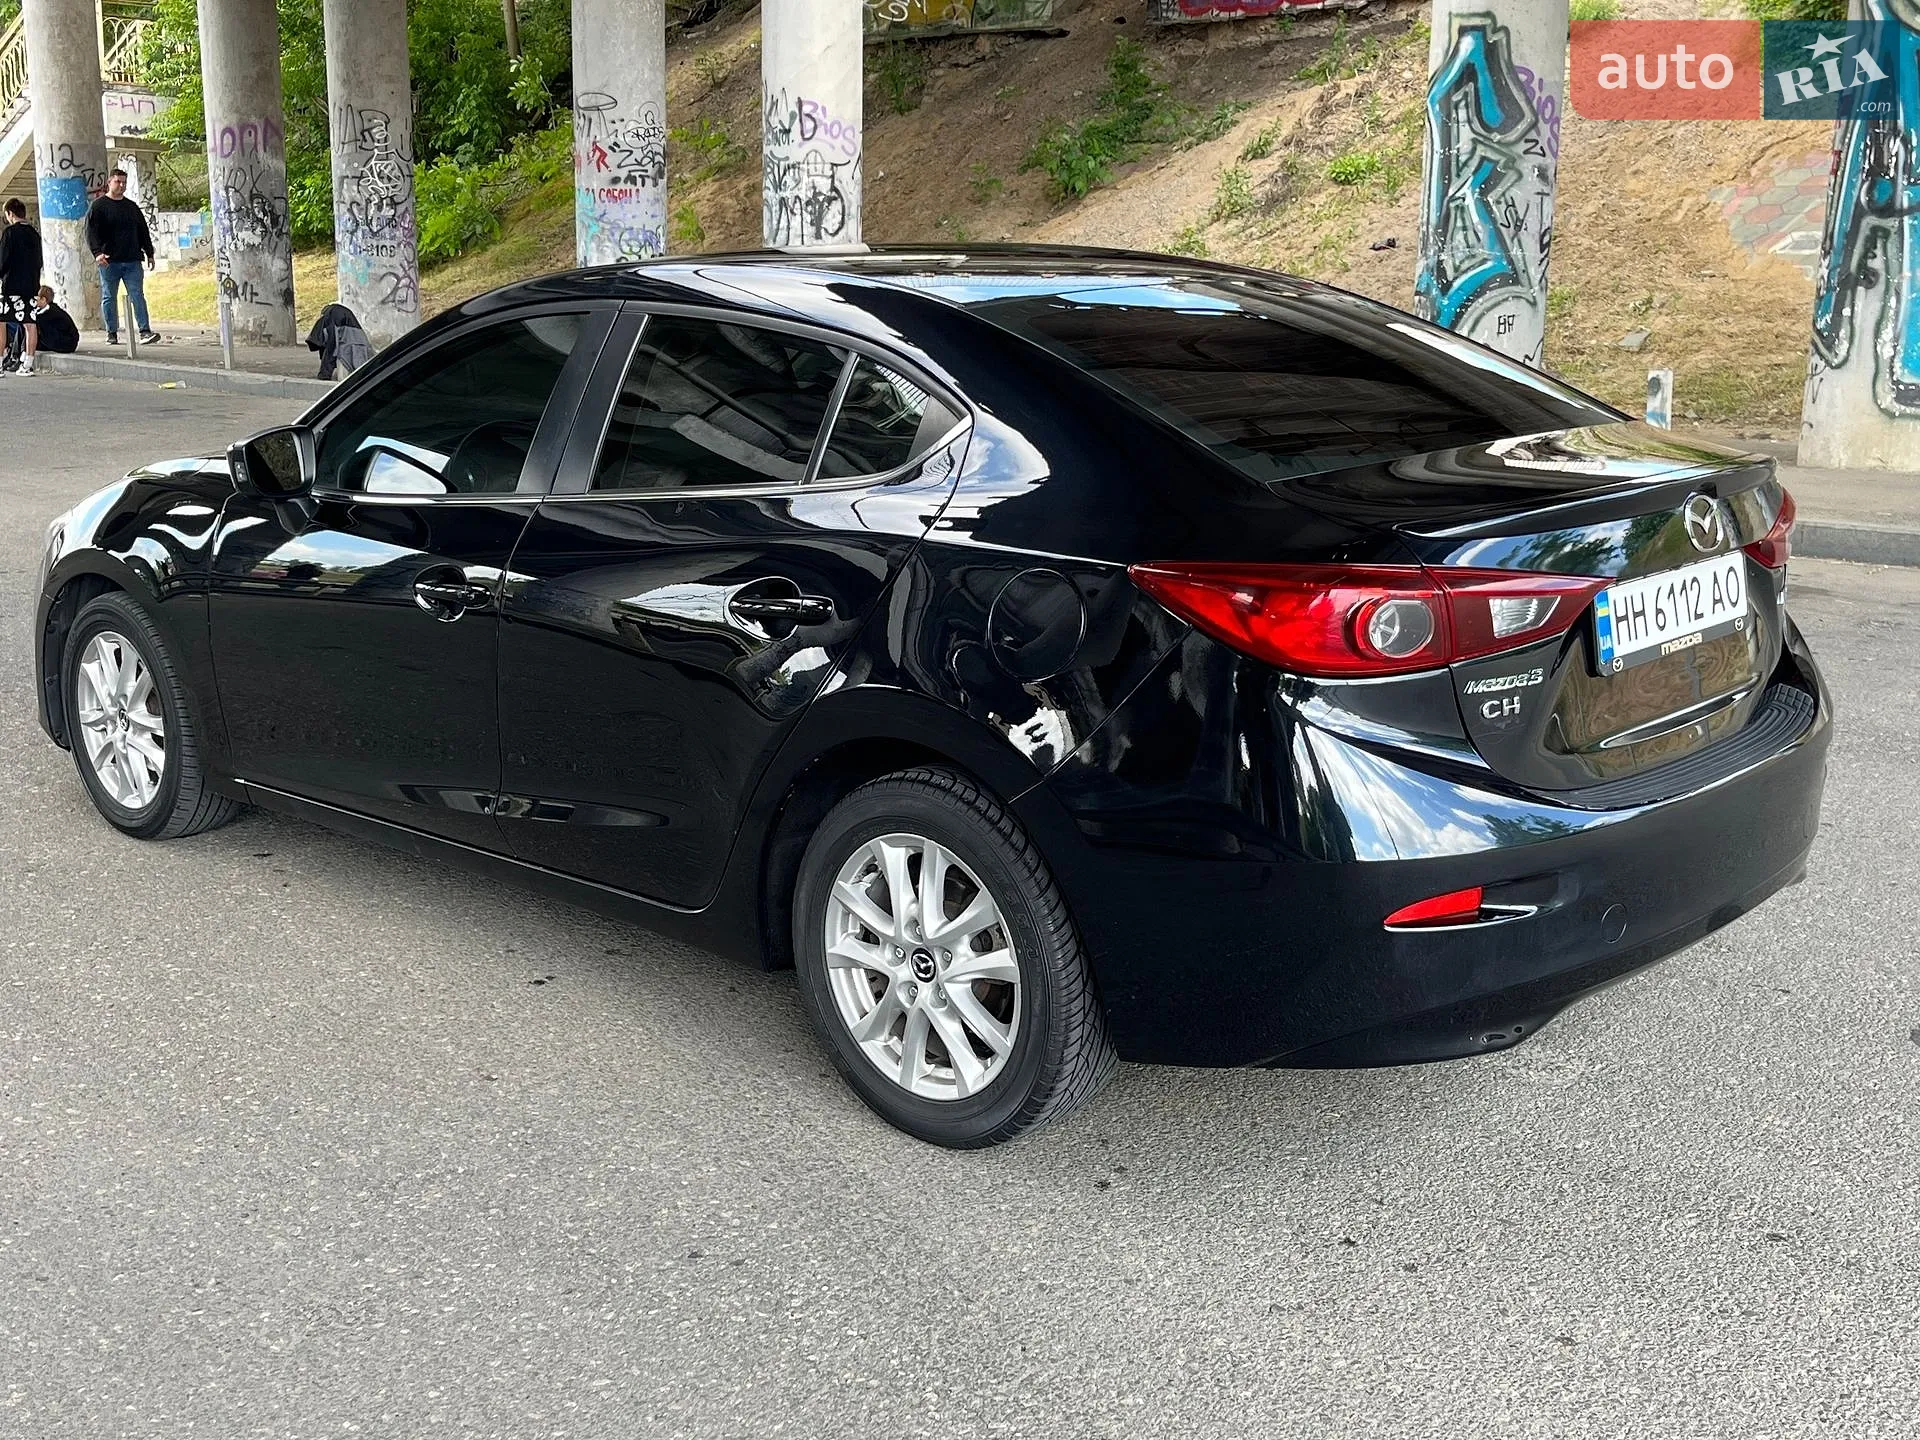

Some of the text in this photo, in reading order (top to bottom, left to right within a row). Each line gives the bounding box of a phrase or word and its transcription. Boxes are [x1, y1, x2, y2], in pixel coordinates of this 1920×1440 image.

[1613, 566, 1740, 646] HH 6112 AO
[1600, 636, 1613, 650] UA
[1482, 696, 1520, 719] CH
